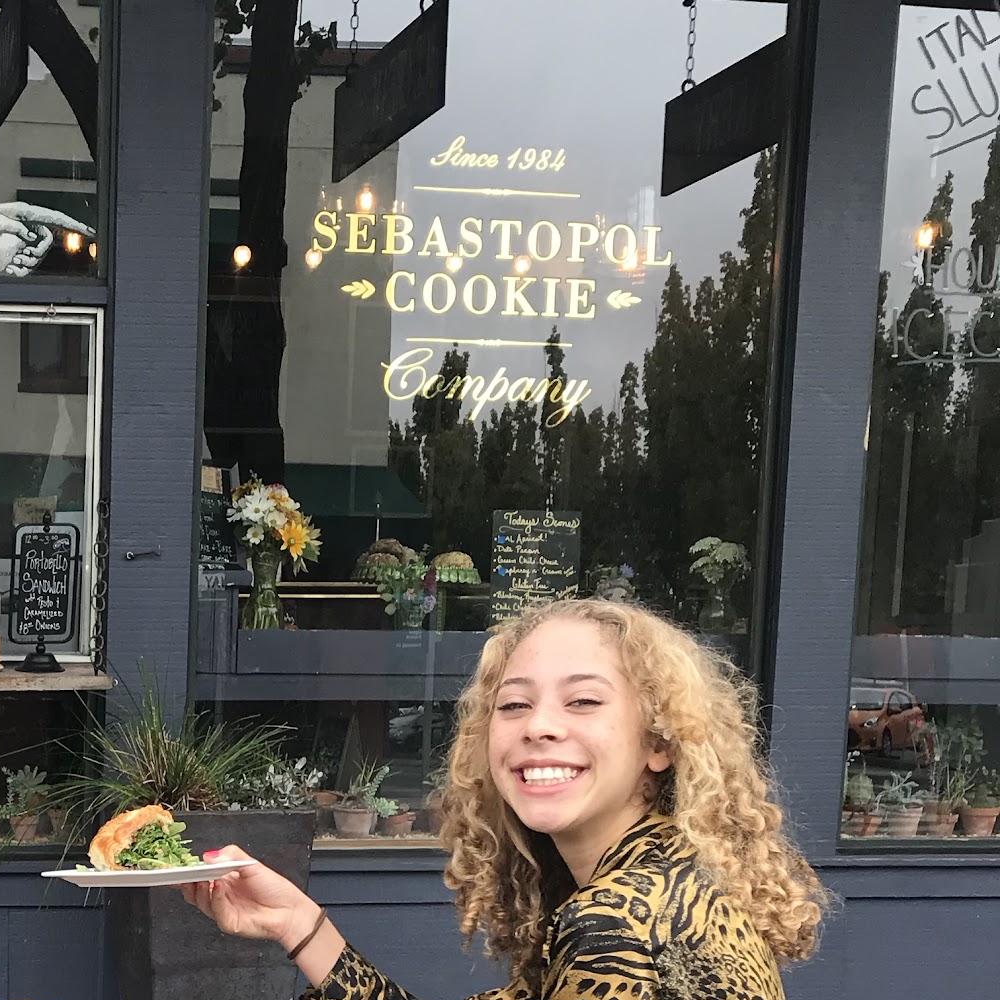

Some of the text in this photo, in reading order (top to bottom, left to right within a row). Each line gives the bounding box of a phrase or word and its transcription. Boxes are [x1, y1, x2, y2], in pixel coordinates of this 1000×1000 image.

[917, 8, 1000, 70] ITAL
[911, 52, 1000, 140] SLU
[430, 135, 567, 171] Since 1984
[313, 210, 673, 267] SEBASTOPOL
[385, 270, 597, 320] COOKIE
[380, 347, 592, 428] Company
